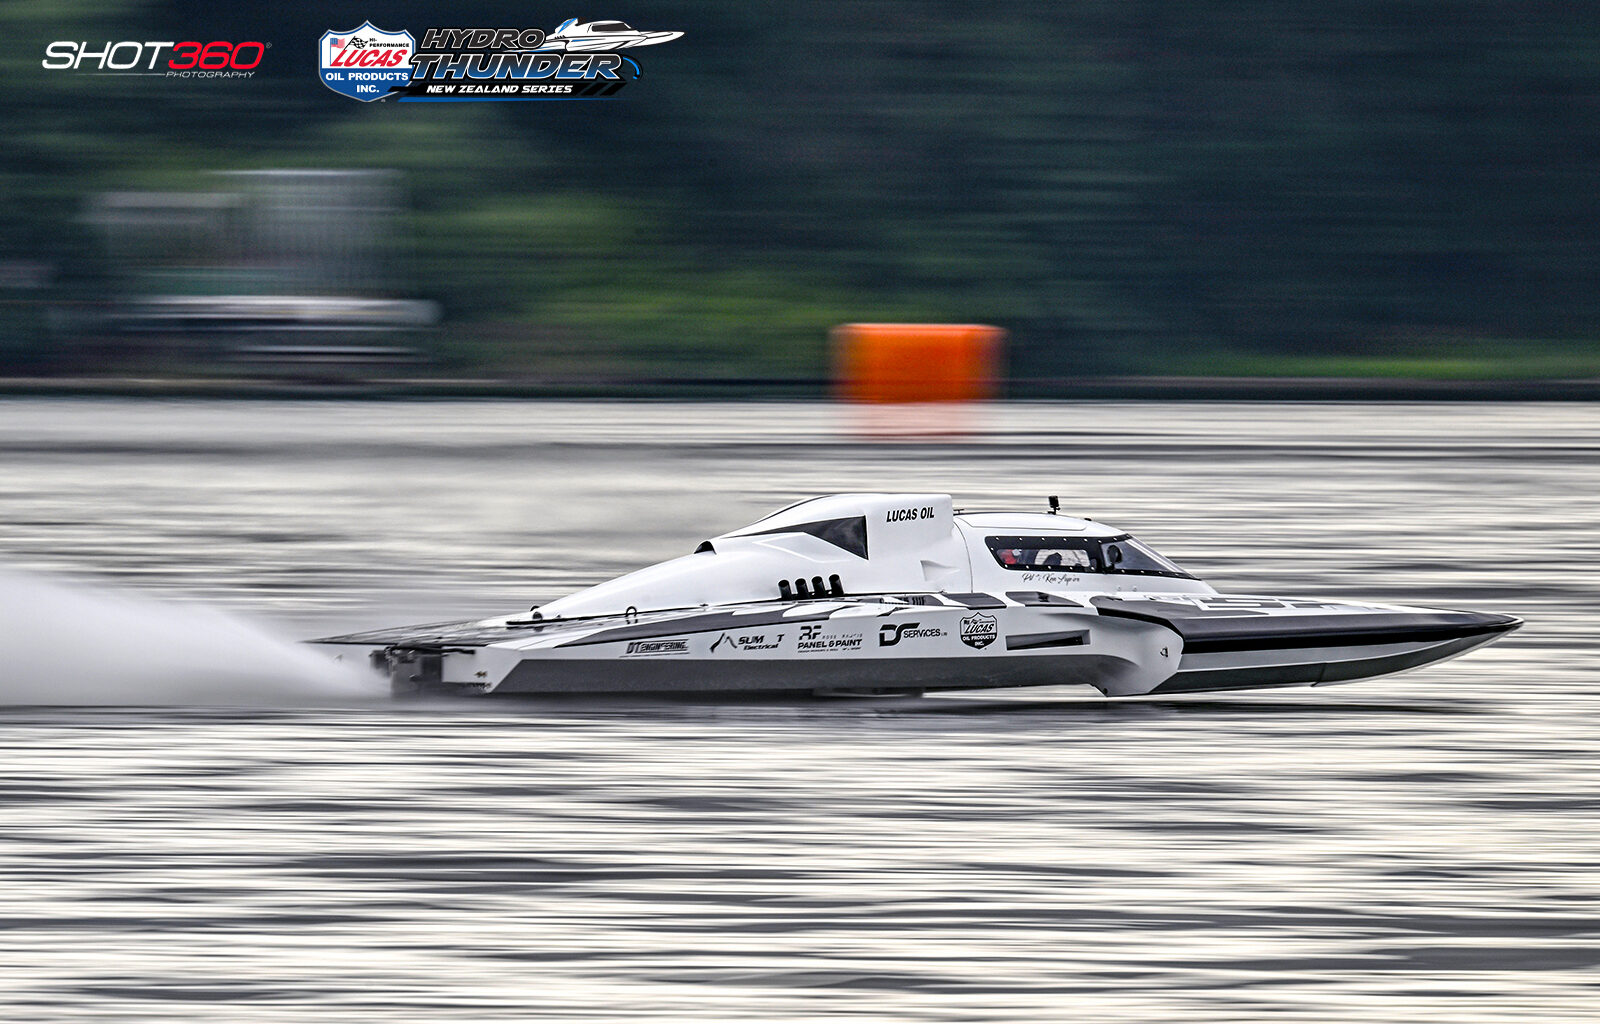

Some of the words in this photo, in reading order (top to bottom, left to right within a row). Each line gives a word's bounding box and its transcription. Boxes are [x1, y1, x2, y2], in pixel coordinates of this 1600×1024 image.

[886, 507, 918, 523] LUCAS
[919, 506, 935, 520] OIL
[798, 625, 822, 641] RF
[879, 622, 921, 647] DS
[964, 623, 995, 634] LUCAS
[743, 643, 779, 651] Electrical
[797, 641, 828, 649] PANEL
[828, 640, 836, 648] &
[835, 639, 863, 647] PAINT
